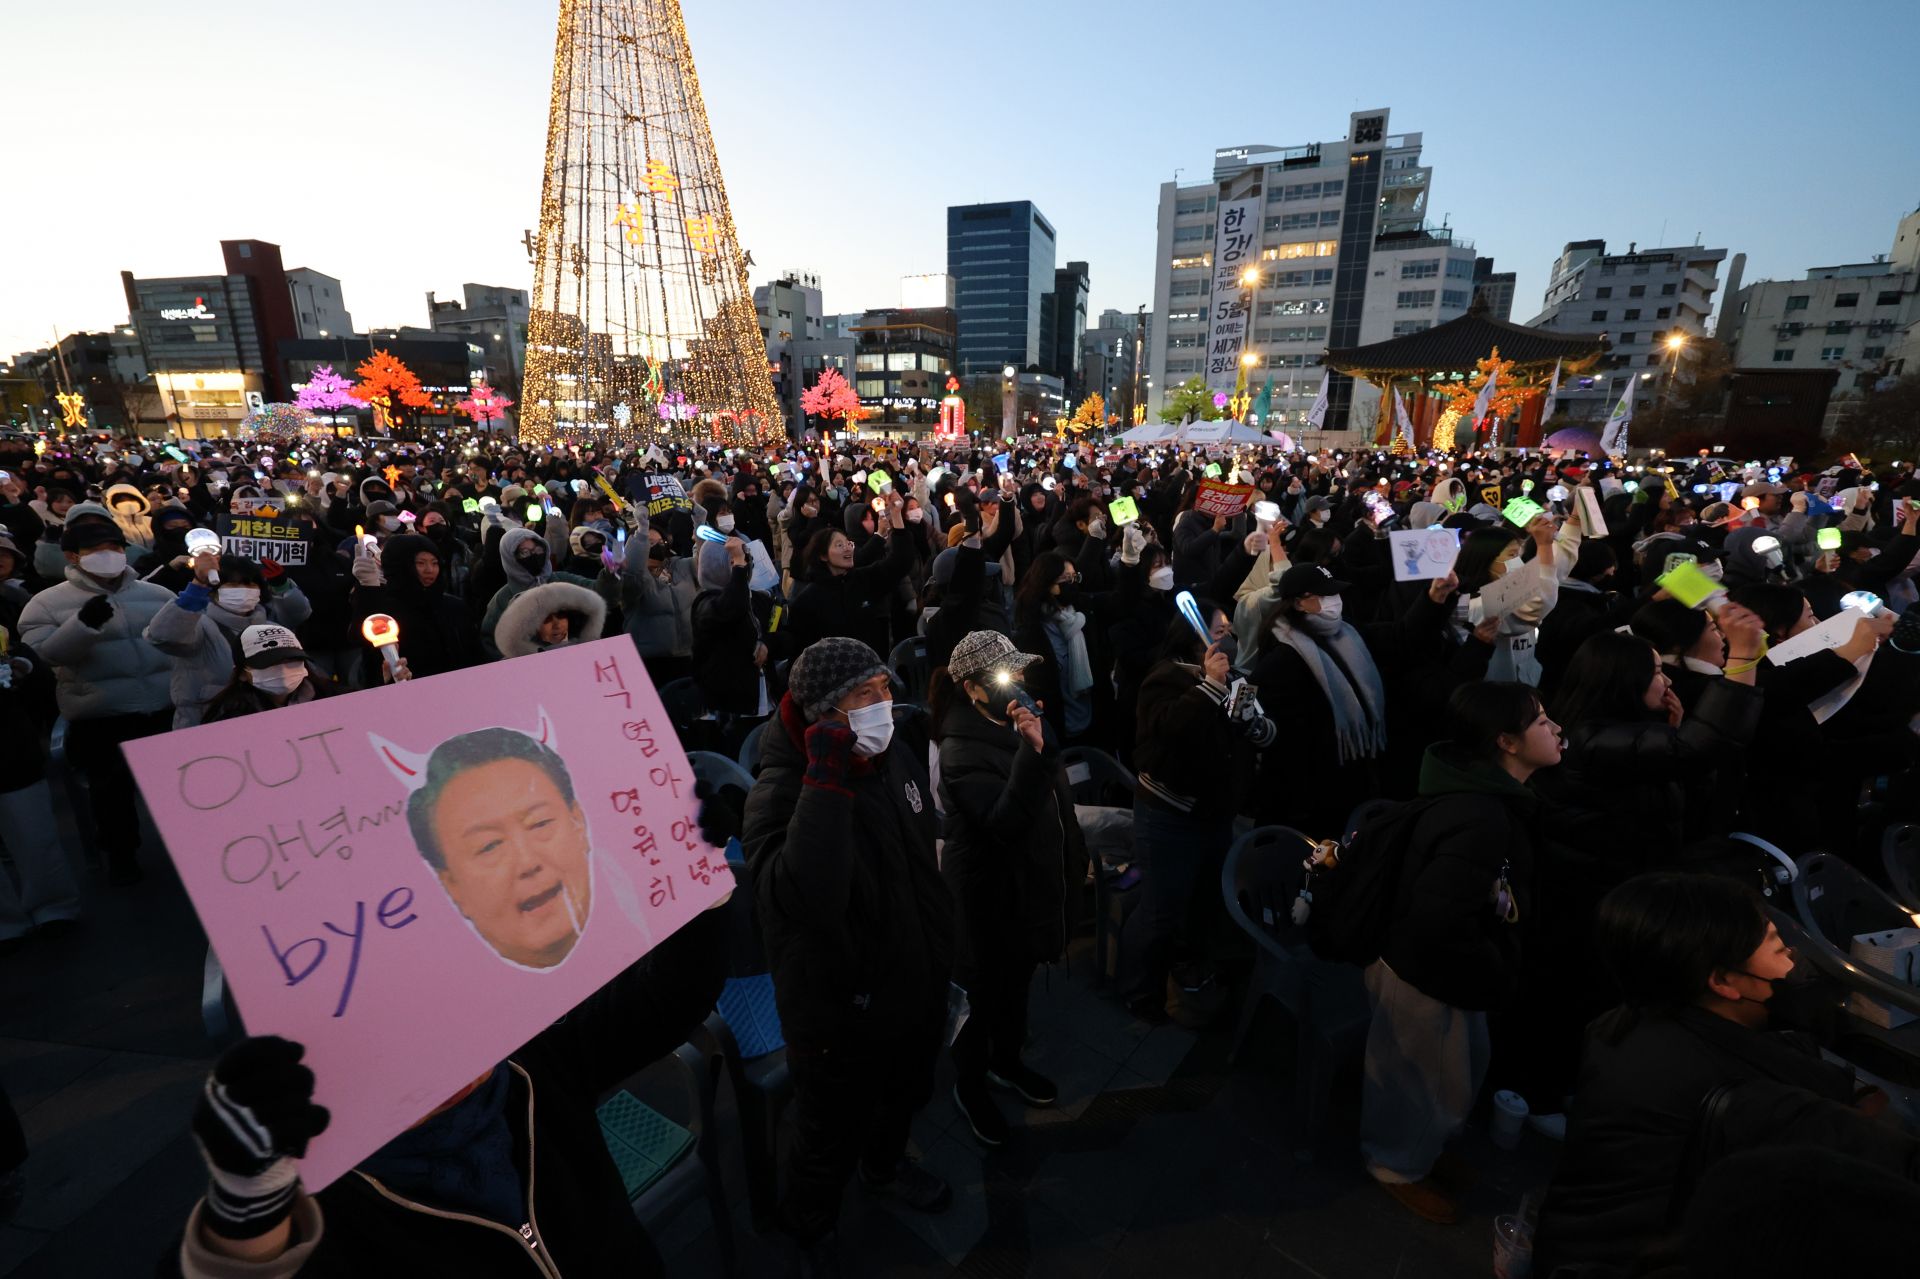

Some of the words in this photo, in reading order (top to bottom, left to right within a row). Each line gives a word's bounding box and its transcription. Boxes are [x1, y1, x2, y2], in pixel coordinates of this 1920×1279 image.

[1355, 128, 1382, 144] 245
[1216, 322, 1244, 335] 이제는
[1212, 336, 1243, 355] 세계
[230, 519, 300, 539] 개헌으로
[224, 538, 306, 563] 사회대개혁
[178, 727, 346, 810] OUT
[610, 787, 677, 908] 영원히
[261, 886, 418, 1018] bye
